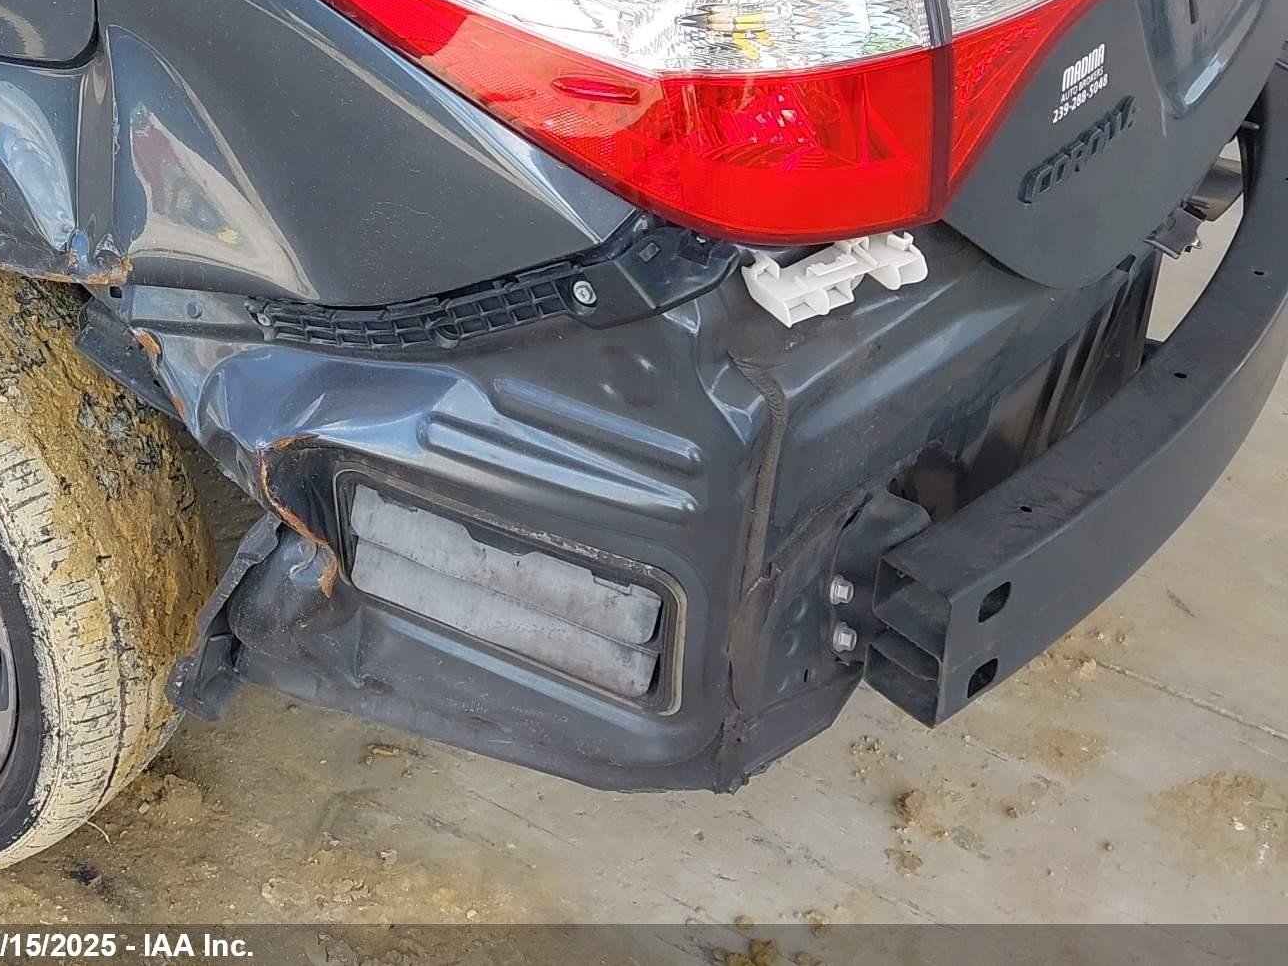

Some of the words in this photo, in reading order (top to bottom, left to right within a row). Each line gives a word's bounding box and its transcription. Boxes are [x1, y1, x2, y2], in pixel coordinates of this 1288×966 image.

[1061, 85, 1078, 104] AUTO
[1078, 66, 1104, 92] BROKERS
[1062, 43, 1105, 92] MADINA
[1052, 73, 1109, 124] 239-288-5048
